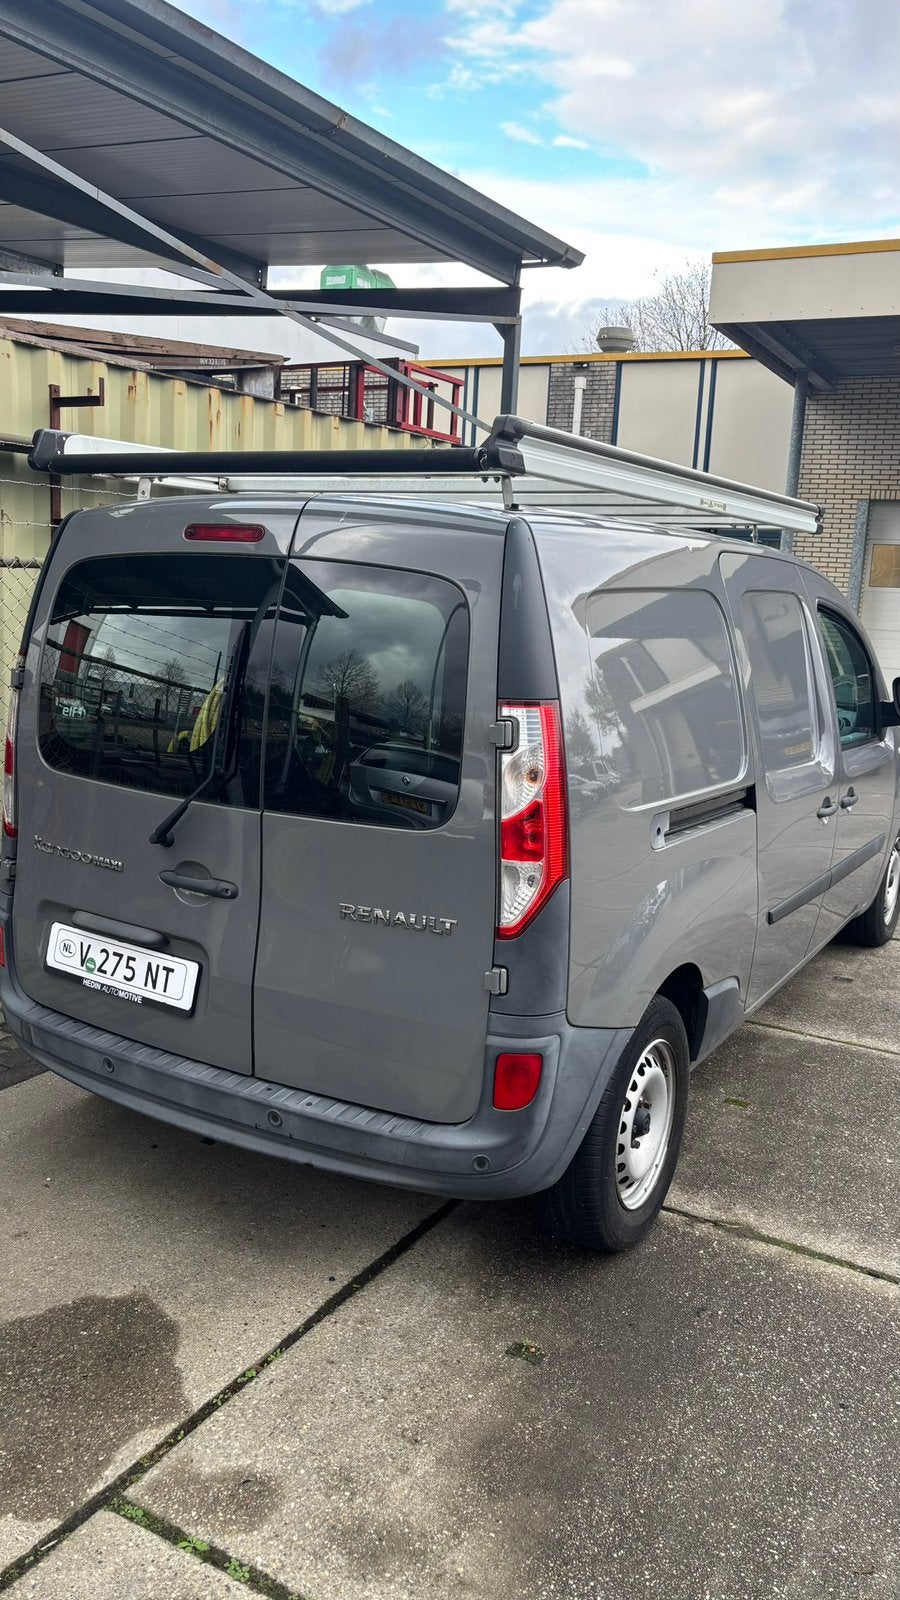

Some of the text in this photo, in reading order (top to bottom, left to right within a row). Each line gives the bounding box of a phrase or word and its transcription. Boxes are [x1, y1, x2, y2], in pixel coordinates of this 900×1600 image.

[92, 855, 123, 872] MAXI
[339, 902, 458, 936] RENAULT
[62, 942, 73, 954] NL
[80, 941, 175, 993] V 275 NT
[82, 978, 143, 1004] HEDIN AUTOMOTIVE
